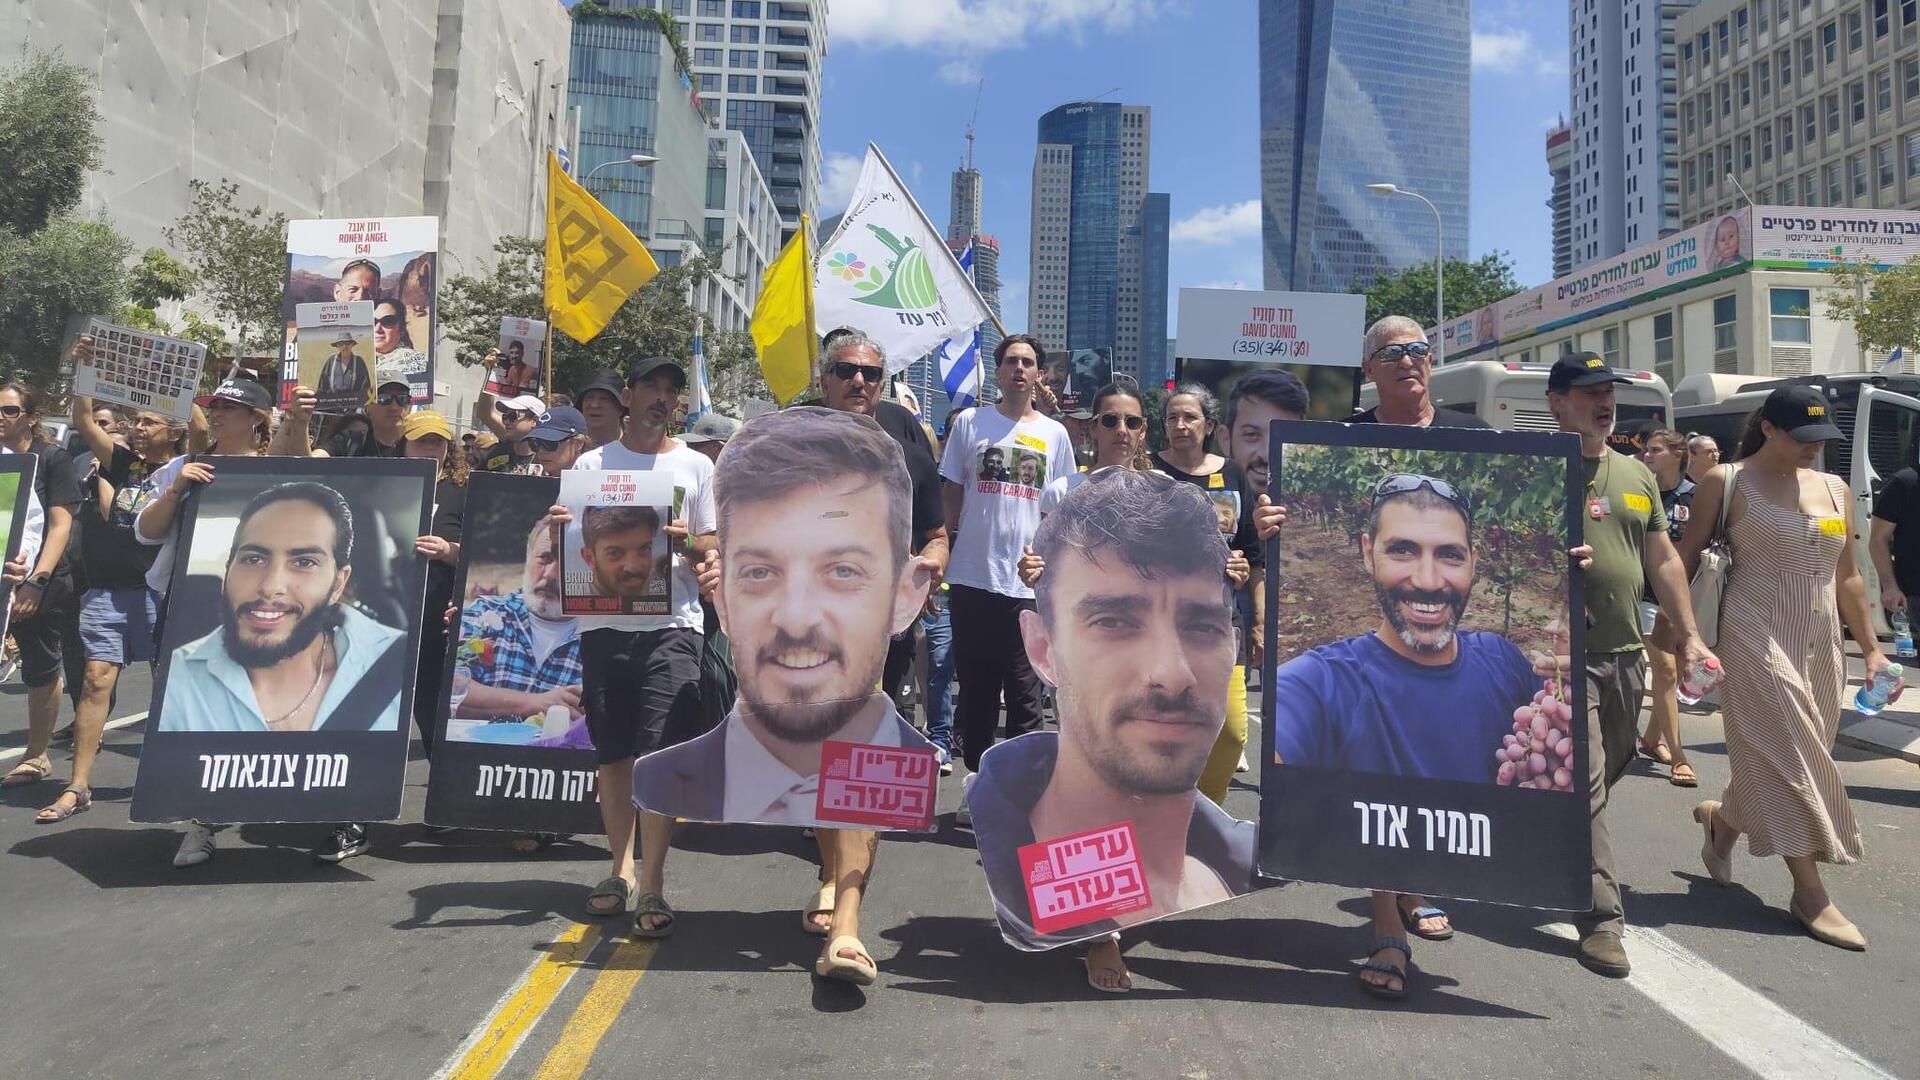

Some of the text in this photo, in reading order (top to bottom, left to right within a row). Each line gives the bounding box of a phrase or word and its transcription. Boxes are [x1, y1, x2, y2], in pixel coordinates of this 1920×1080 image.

[348, 222, 366, 232] אנגל
[1762, 217, 1816, 230] פרטיים
[1821, 219, 1878, 233] לחדרים
[338, 232, 388, 243] RONEN ANGEL
[1785, 234, 1904, 246] במחלקות היולדות בבילינסון
[355, 244, 371, 254] (54)
[1666, 236, 1696, 259] נולדנו
[1666, 255, 1697, 276] מחדש
[1557, 250, 1661, 300] עברנו לחדרים פרטיים
[1617, 276, 1645, 293] במחלקות
[926, 311, 946, 327] ניר
[1252, 307, 1293, 323] דוד קוניו
[1242, 323, 1297, 339] DAVID CUNIO
[283, 361, 298, 380] HI
[1611, 434, 1629, 444] מטר
[601, 484, 636, 492] DAVID CUNIO
[978, 481, 1001, 494] UERZA
[565, 570, 593, 582] BRING
[199, 754, 349, 792] מתן צנגאוקר
[856, 752, 928, 779] עדיין
[475, 764, 600, 803] יהו מרגלית
[834, 784, 924, 814] בעזה.
[1353, 801, 1491, 857] תמיר אדר
[1055, 831, 1129, 875] עדיין
[1049, 868, 1140, 912] בעזה.
